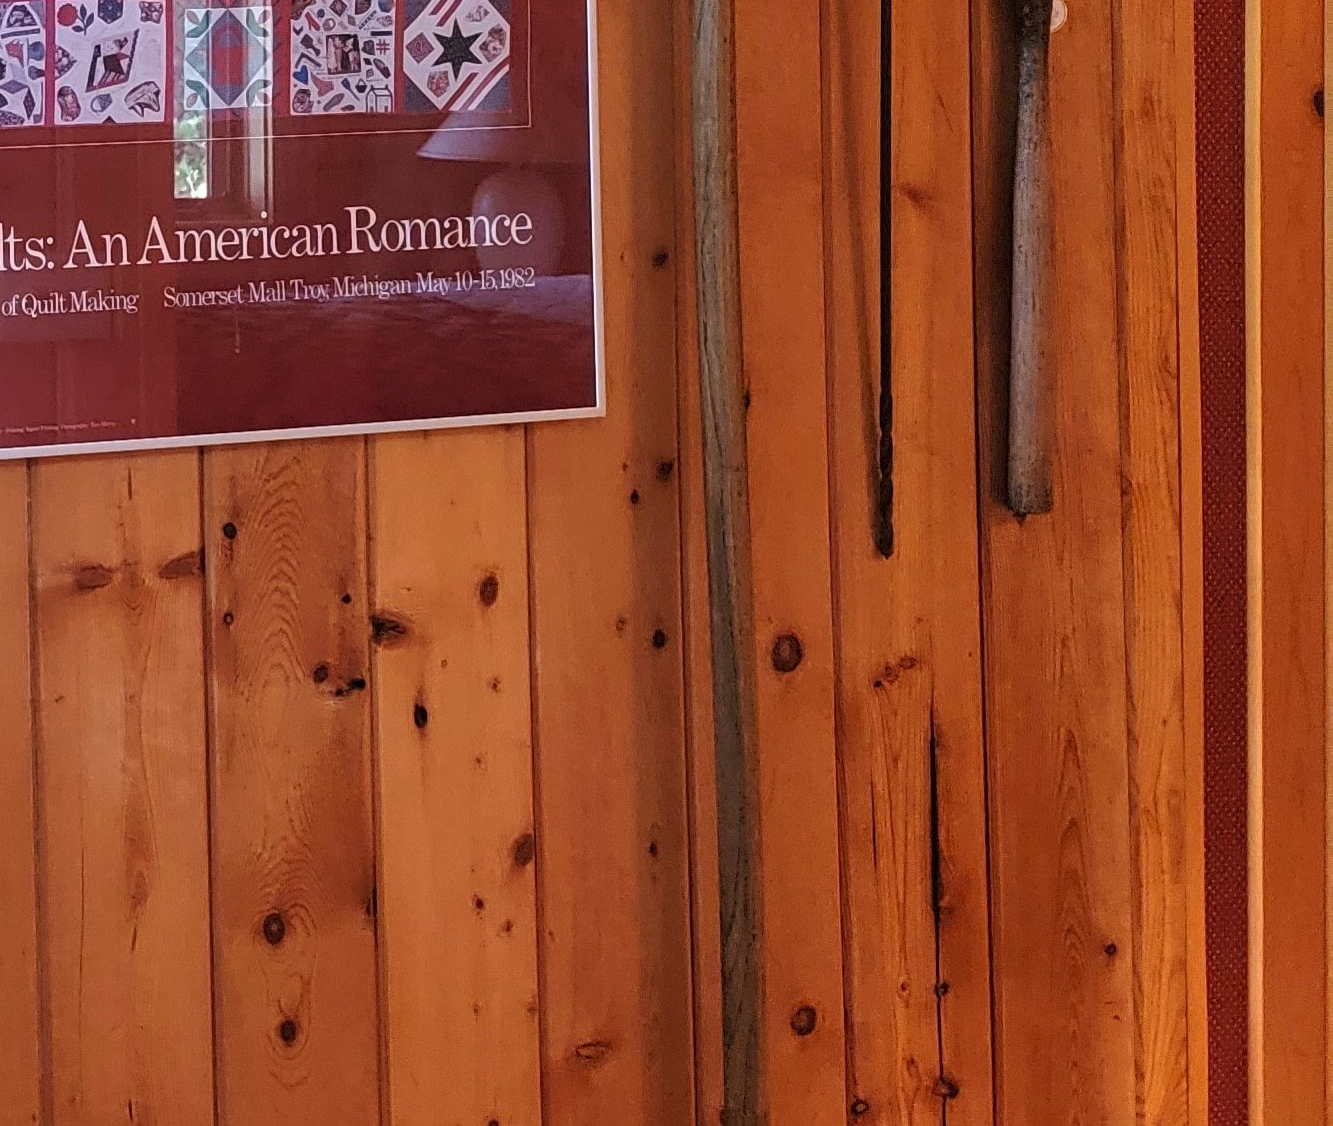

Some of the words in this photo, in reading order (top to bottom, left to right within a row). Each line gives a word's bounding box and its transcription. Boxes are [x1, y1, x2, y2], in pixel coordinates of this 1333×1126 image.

[62, 219, 132, 269] An
[137, 210, 341, 265] American
[344, 205, 533, 254] Romance
[1, 293, 20, 316] of
[21, 291, 67, 318] Quilt
[69, 289, 140, 313] Making
[163, 285, 244, 308] Somerset
[248, 281, 286, 303] Mall
[290, 276, 330, 302] Troy,
[332, 273, 410, 299] Michigan
[415, 270, 452, 295] May
